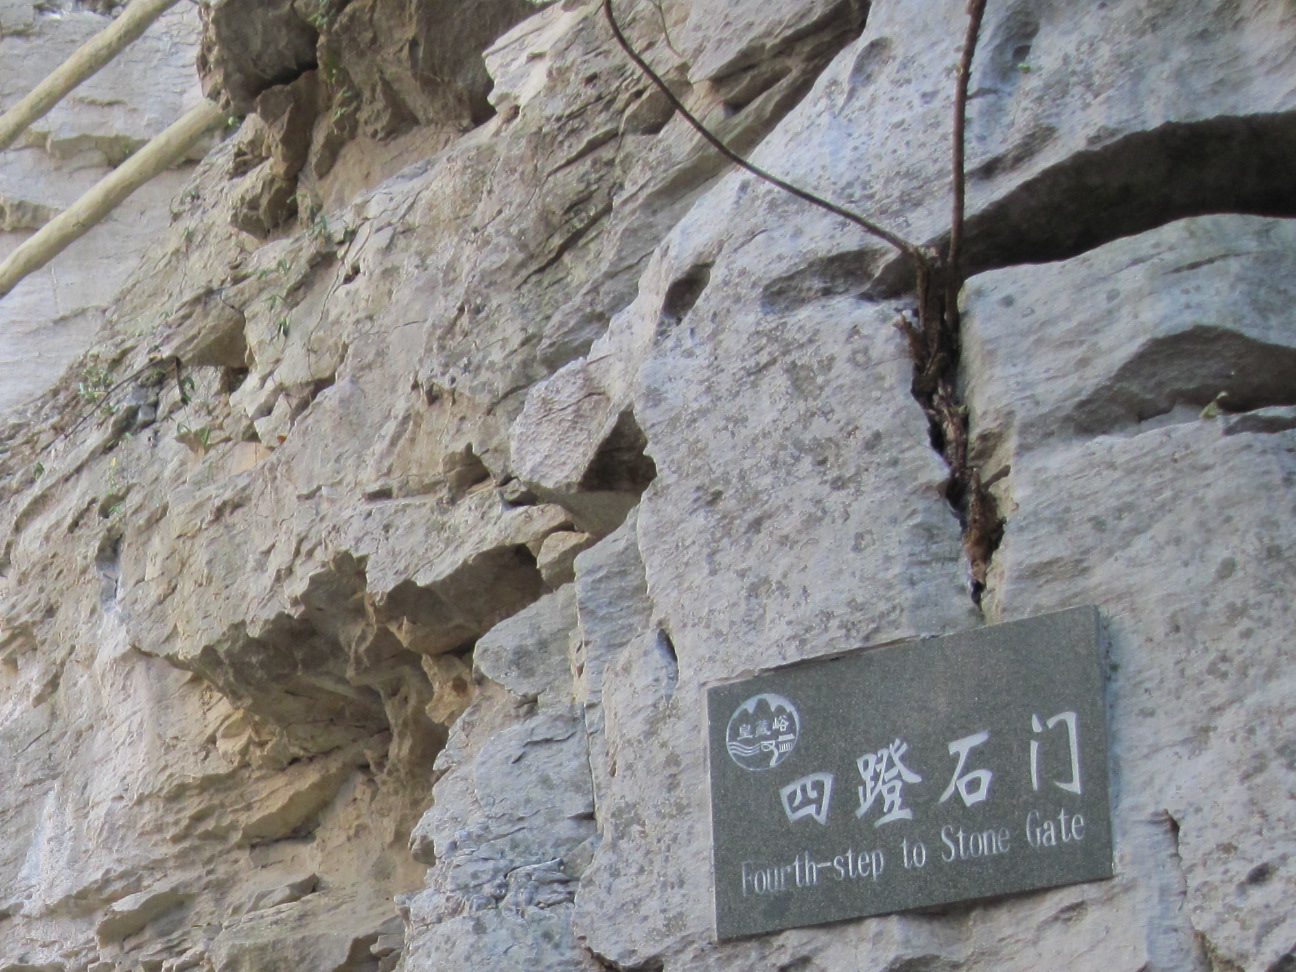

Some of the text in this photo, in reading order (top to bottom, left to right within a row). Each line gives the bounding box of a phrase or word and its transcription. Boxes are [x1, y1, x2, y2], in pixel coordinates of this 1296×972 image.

[779, 711, 1082, 828] 四蹬石门
[741, 809, 1085, 896] Fourth-step to Stone Gate
